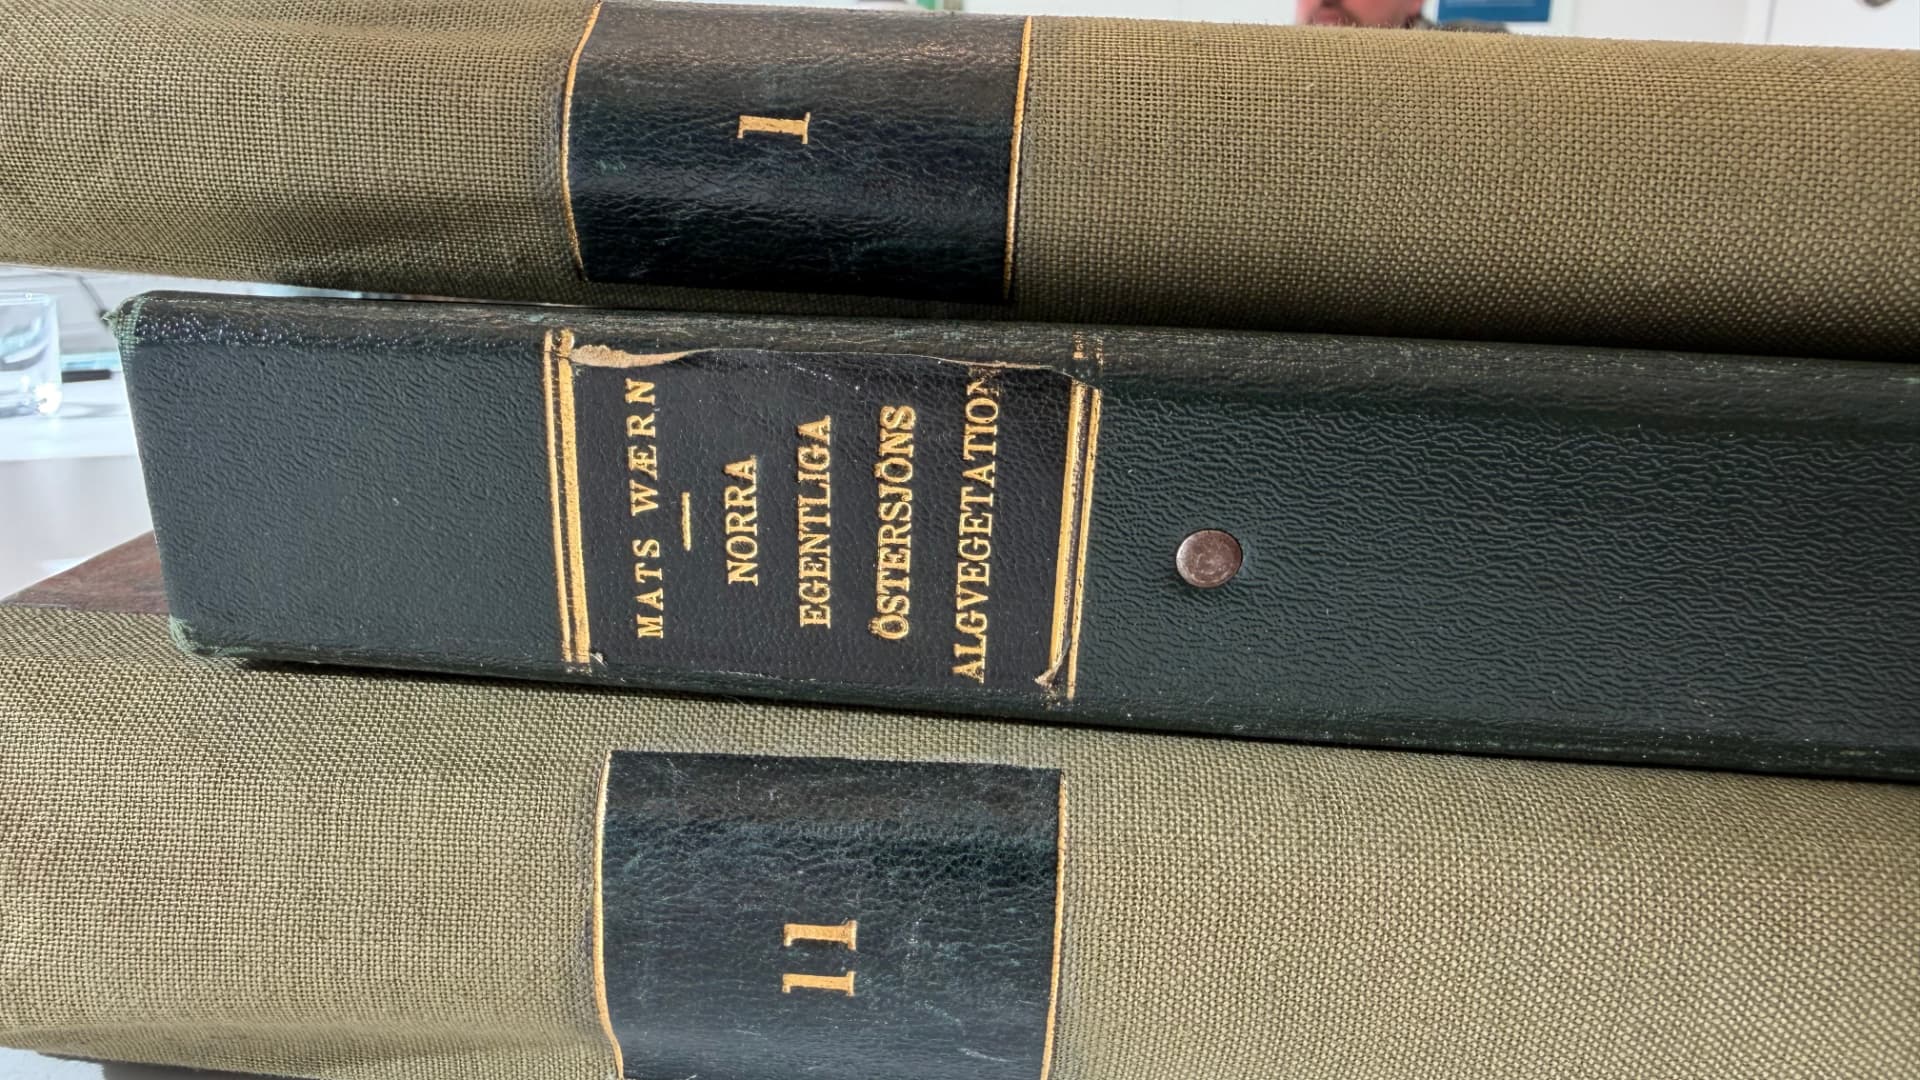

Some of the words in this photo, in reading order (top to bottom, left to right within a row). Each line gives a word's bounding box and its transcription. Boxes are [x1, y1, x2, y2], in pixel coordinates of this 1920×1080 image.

[737, 111, 811, 145] 1
[625, 378, 658, 516] WÆRN
[724, 455, 759, 586] NORRA
[797, 415, 833, 628] EGENTLIGA
[869, 405, 918, 641] ÖSTERSJÖNS
[952, 372, 1001, 684] ALGVEGETATION
[631, 538, 665, 640] MATS
[782, 919, 858, 998] 11
